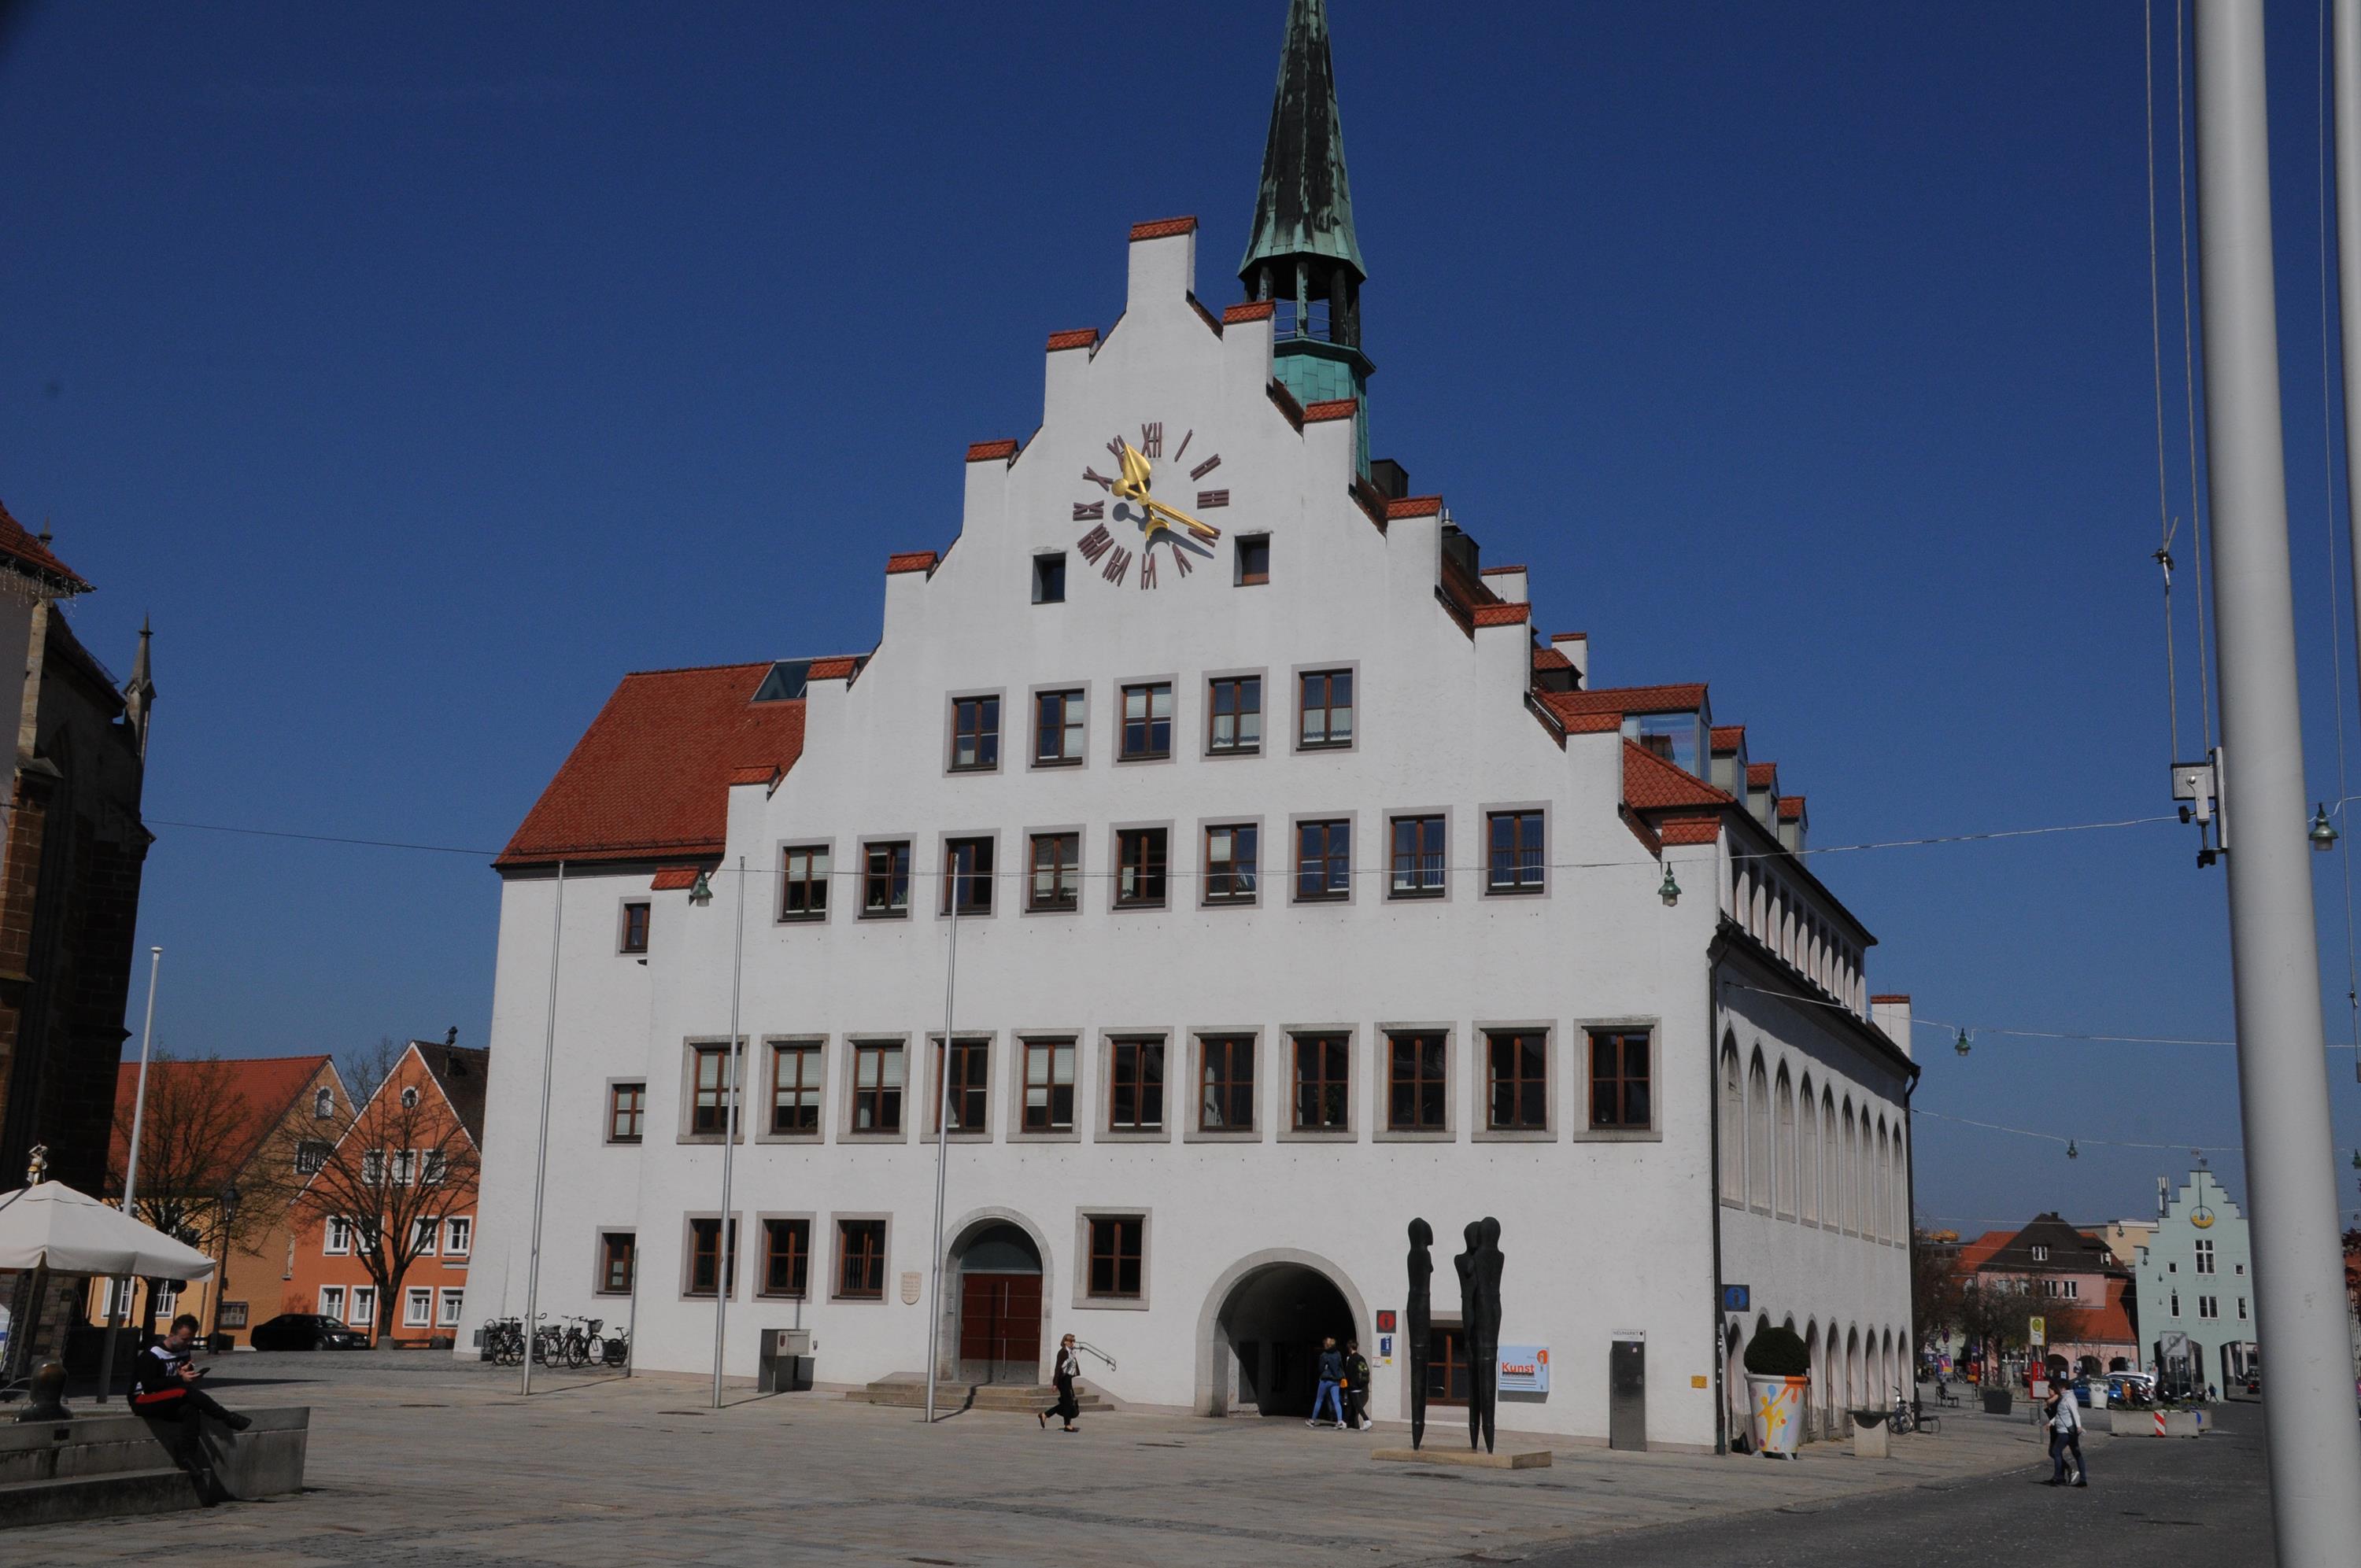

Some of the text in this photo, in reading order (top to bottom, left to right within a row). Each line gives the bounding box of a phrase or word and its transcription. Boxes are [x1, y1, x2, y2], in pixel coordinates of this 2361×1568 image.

[1141, 422, 1162, 459] XII
[1082, 466, 1114, 493] X
[1190, 453, 1221, 482] II
[1197, 489, 1229, 510] III
[1172, 544, 1192, 578] V
[1502, 1362, 1535, 1373] Kunst
